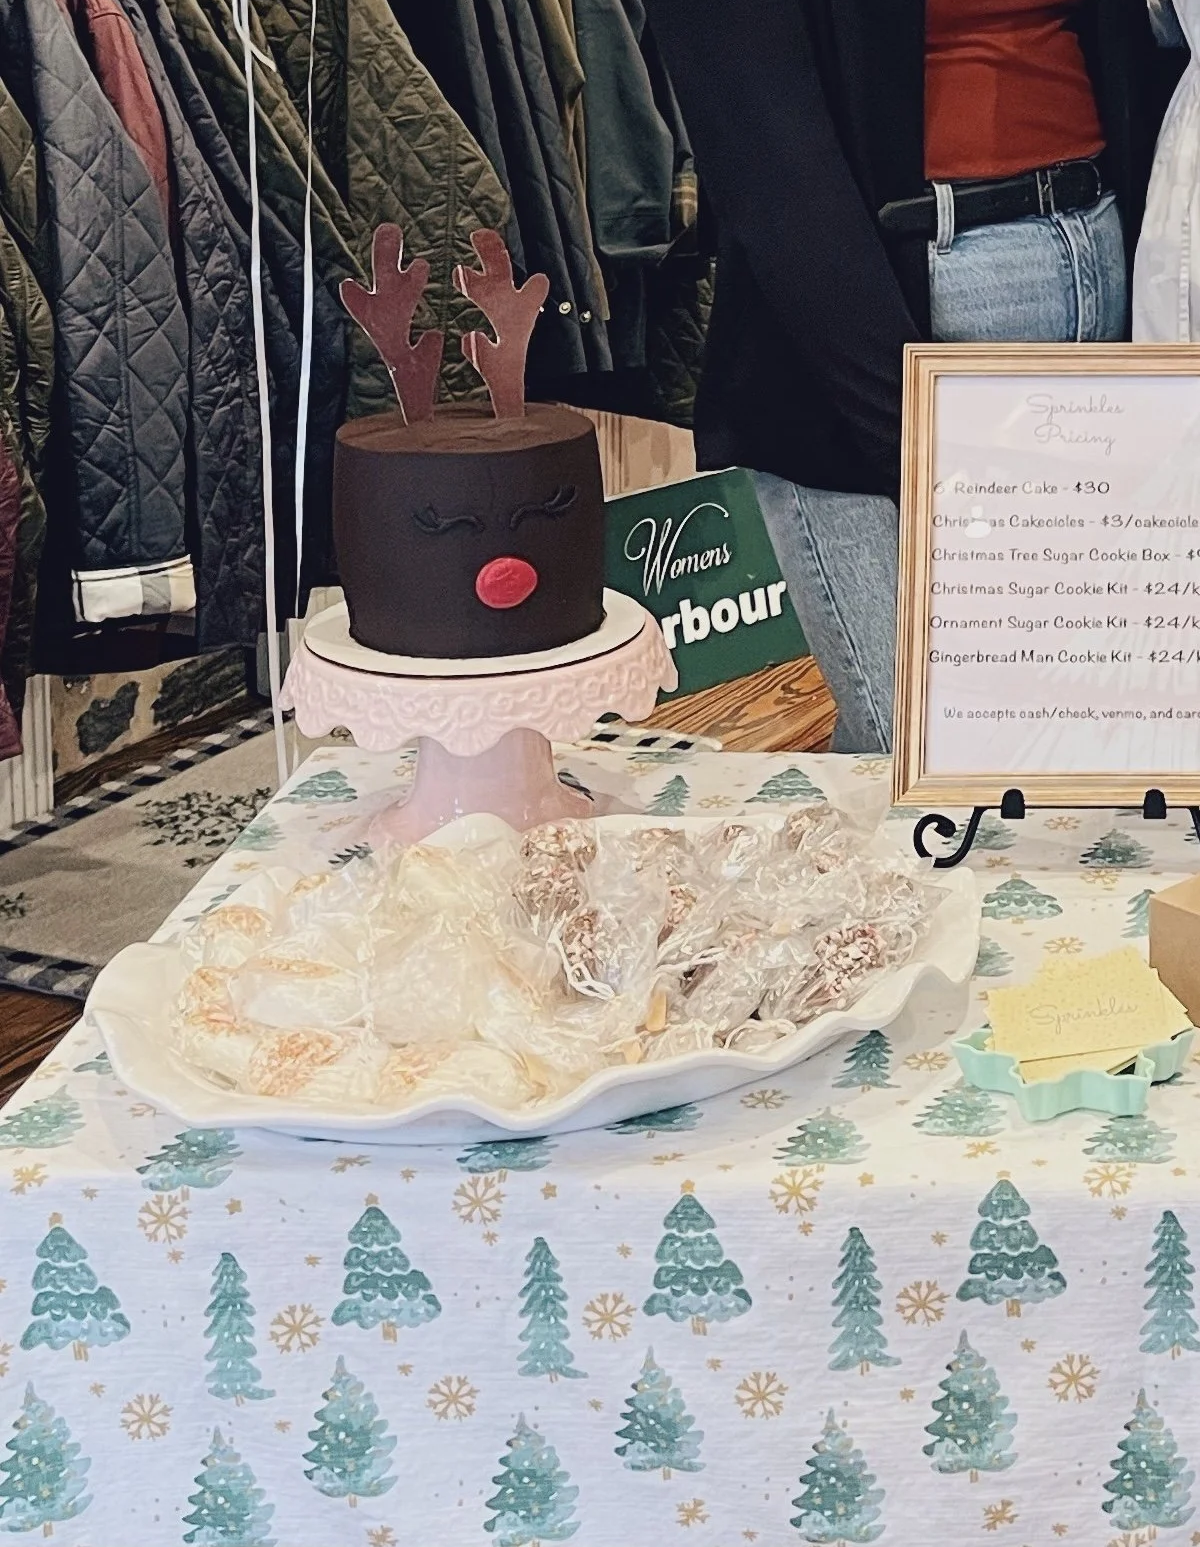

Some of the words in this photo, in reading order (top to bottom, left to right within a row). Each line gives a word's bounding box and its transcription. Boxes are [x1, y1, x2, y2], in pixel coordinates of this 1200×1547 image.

[1026, 393, 1124, 425] Sprinkles
[1034, 423, 1116, 456] Pricing
[954, 481, 1018, 494] Reindeer
[1022, 481, 1058, 494] Cake
[1072, 480, 1110, 494] $30
[932, 514, 1005, 528] Chrisas
[1009, 514, 1085, 528] Cakecicles
[625, 503, 731, 596] Womens
[931, 548, 1004, 561] Christmas
[1009, 548, 1038, 561] Tree
[1043, 548, 1084, 564] Sugar
[1089, 548, 1137, 561] Cookie
[1142, 548, 1170, 561] Box
[931, 582, 1004, 595] Christmas
[1008, 582, 1050, 598] Sugar
[1054, 582, 1104, 595] Cookie
[1107, 582, 1128, 595] Kit
[661, 580, 787, 650] rbour
[930, 616, 1002, 629] Ornament
[1008, 616, 1050, 633] Sugar
[1053, 616, 1102, 629] Cookie
[1106, 616, 1127, 629] Kit
[929, 650, 1017, 666] Gingerbread
[1021, 650, 1054, 663] Man
[1057, 650, 1107, 663] Cookie
[1111, 650, 1132, 663] Kit
[943, 707, 963, 719] We
[966, 708, 1017, 722] accepts
[1101, 710, 1147, 721] venmo,
[1149, 708, 1173, 719] and
[1029, 997, 1138, 1035] Sprinkles
